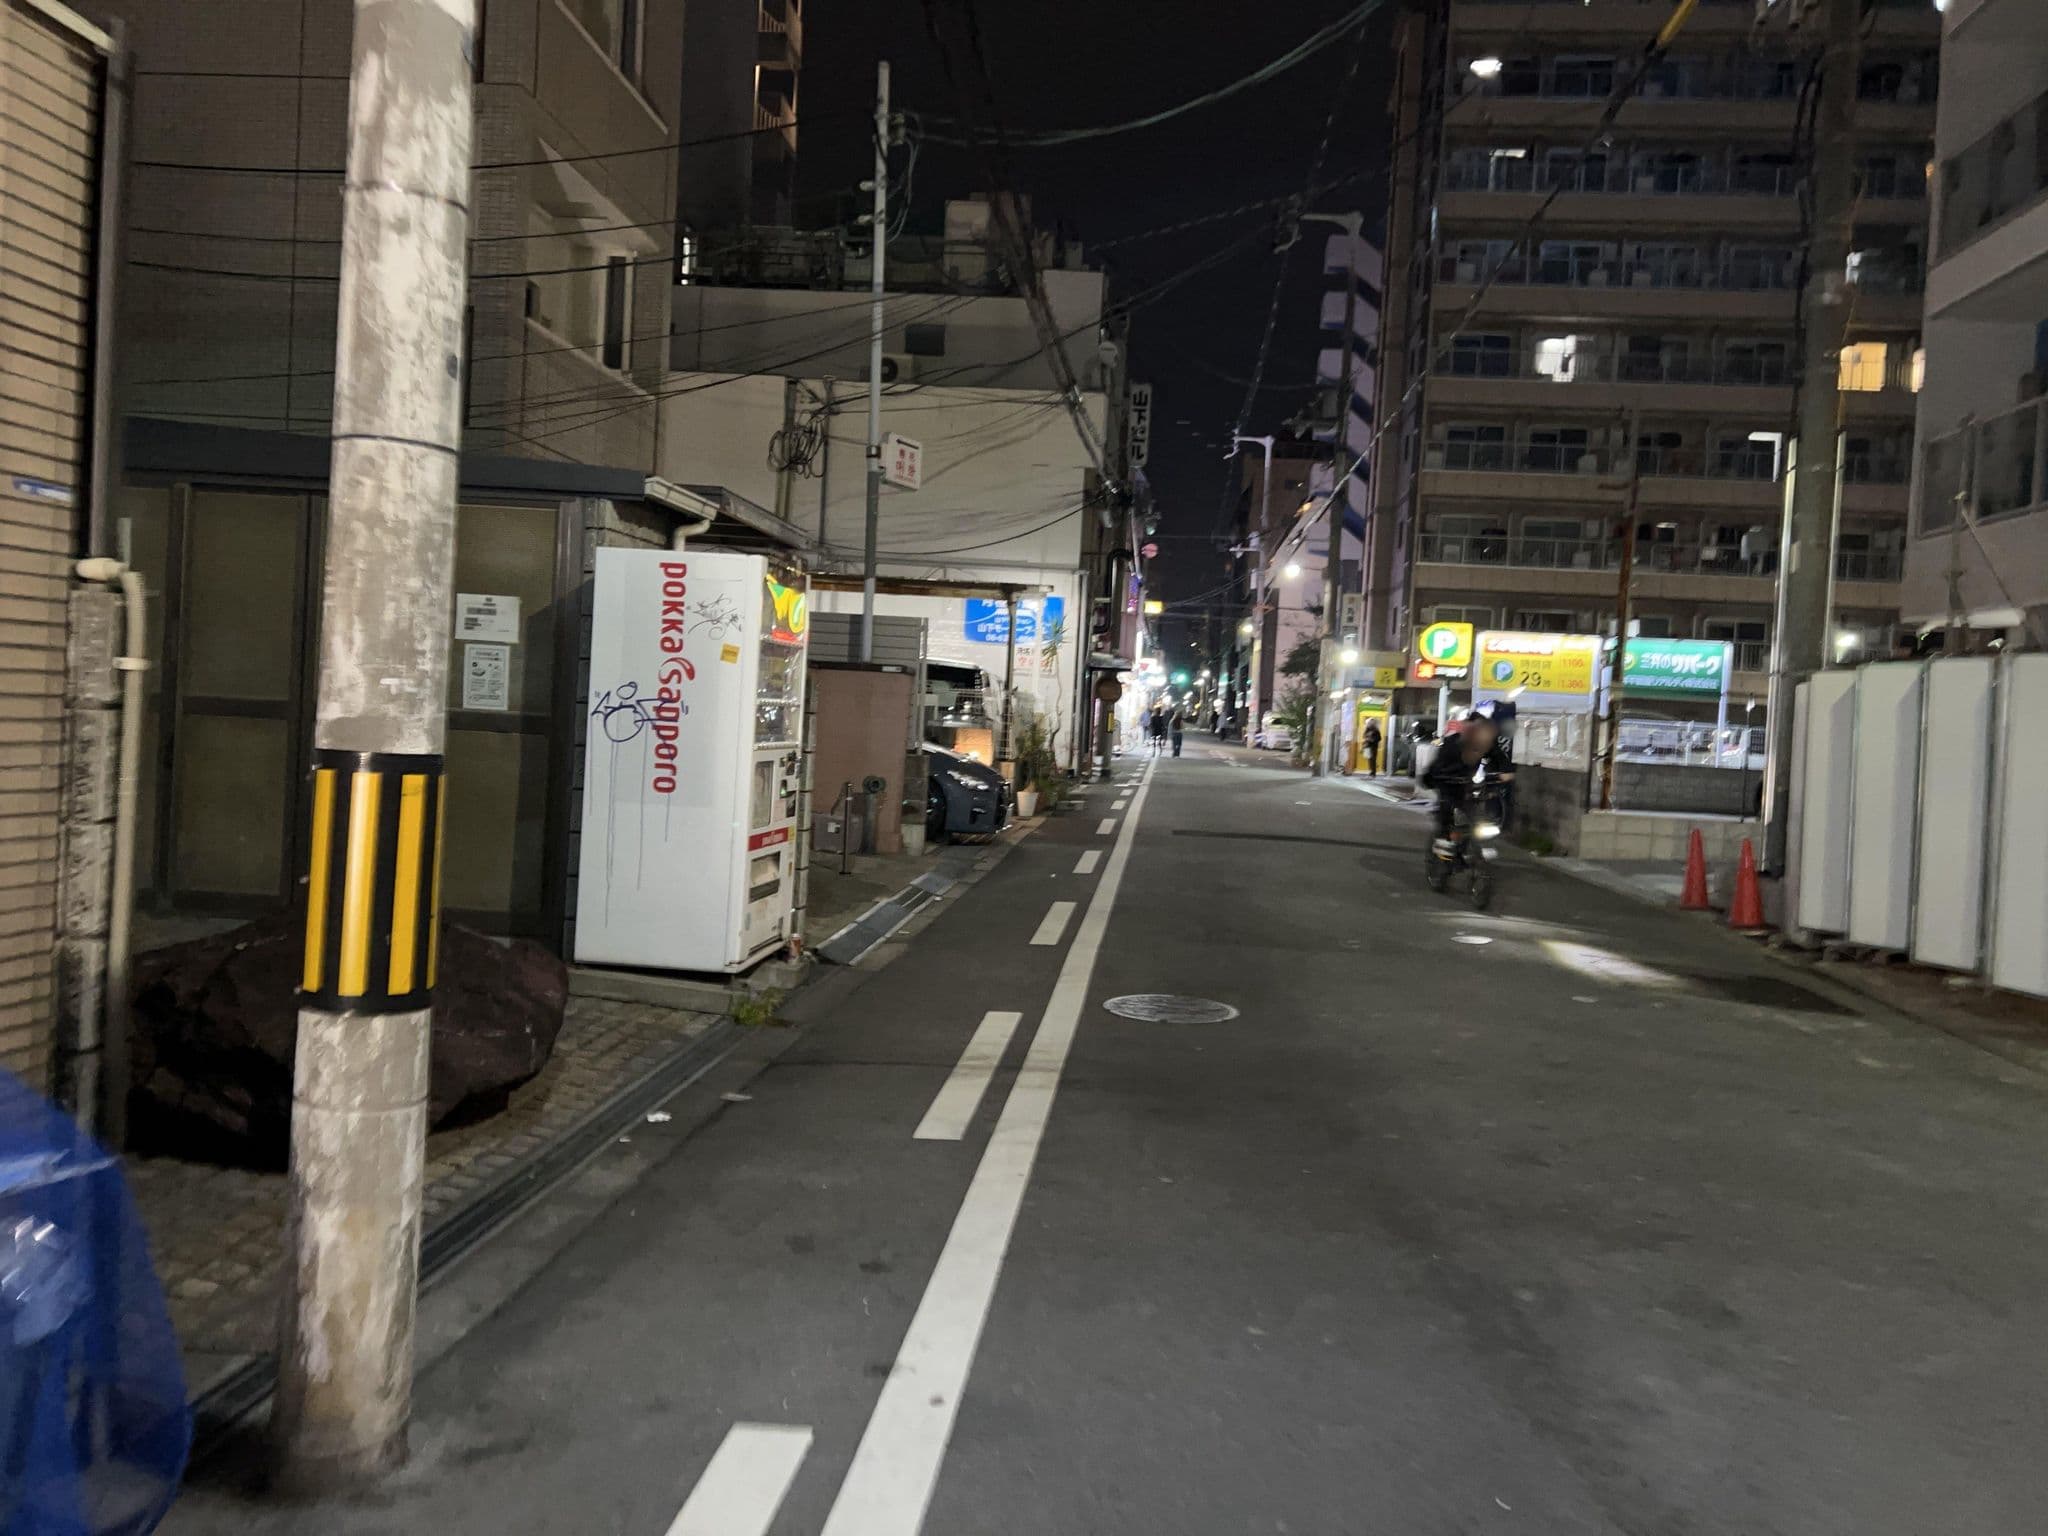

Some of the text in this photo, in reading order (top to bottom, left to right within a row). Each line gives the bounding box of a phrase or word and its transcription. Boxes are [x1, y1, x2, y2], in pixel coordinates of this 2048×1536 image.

[1131, 391, 1148, 460] 山下ビル
[1432, 630, 1457, 658] P
[652, 668, 683, 793] sapporo
